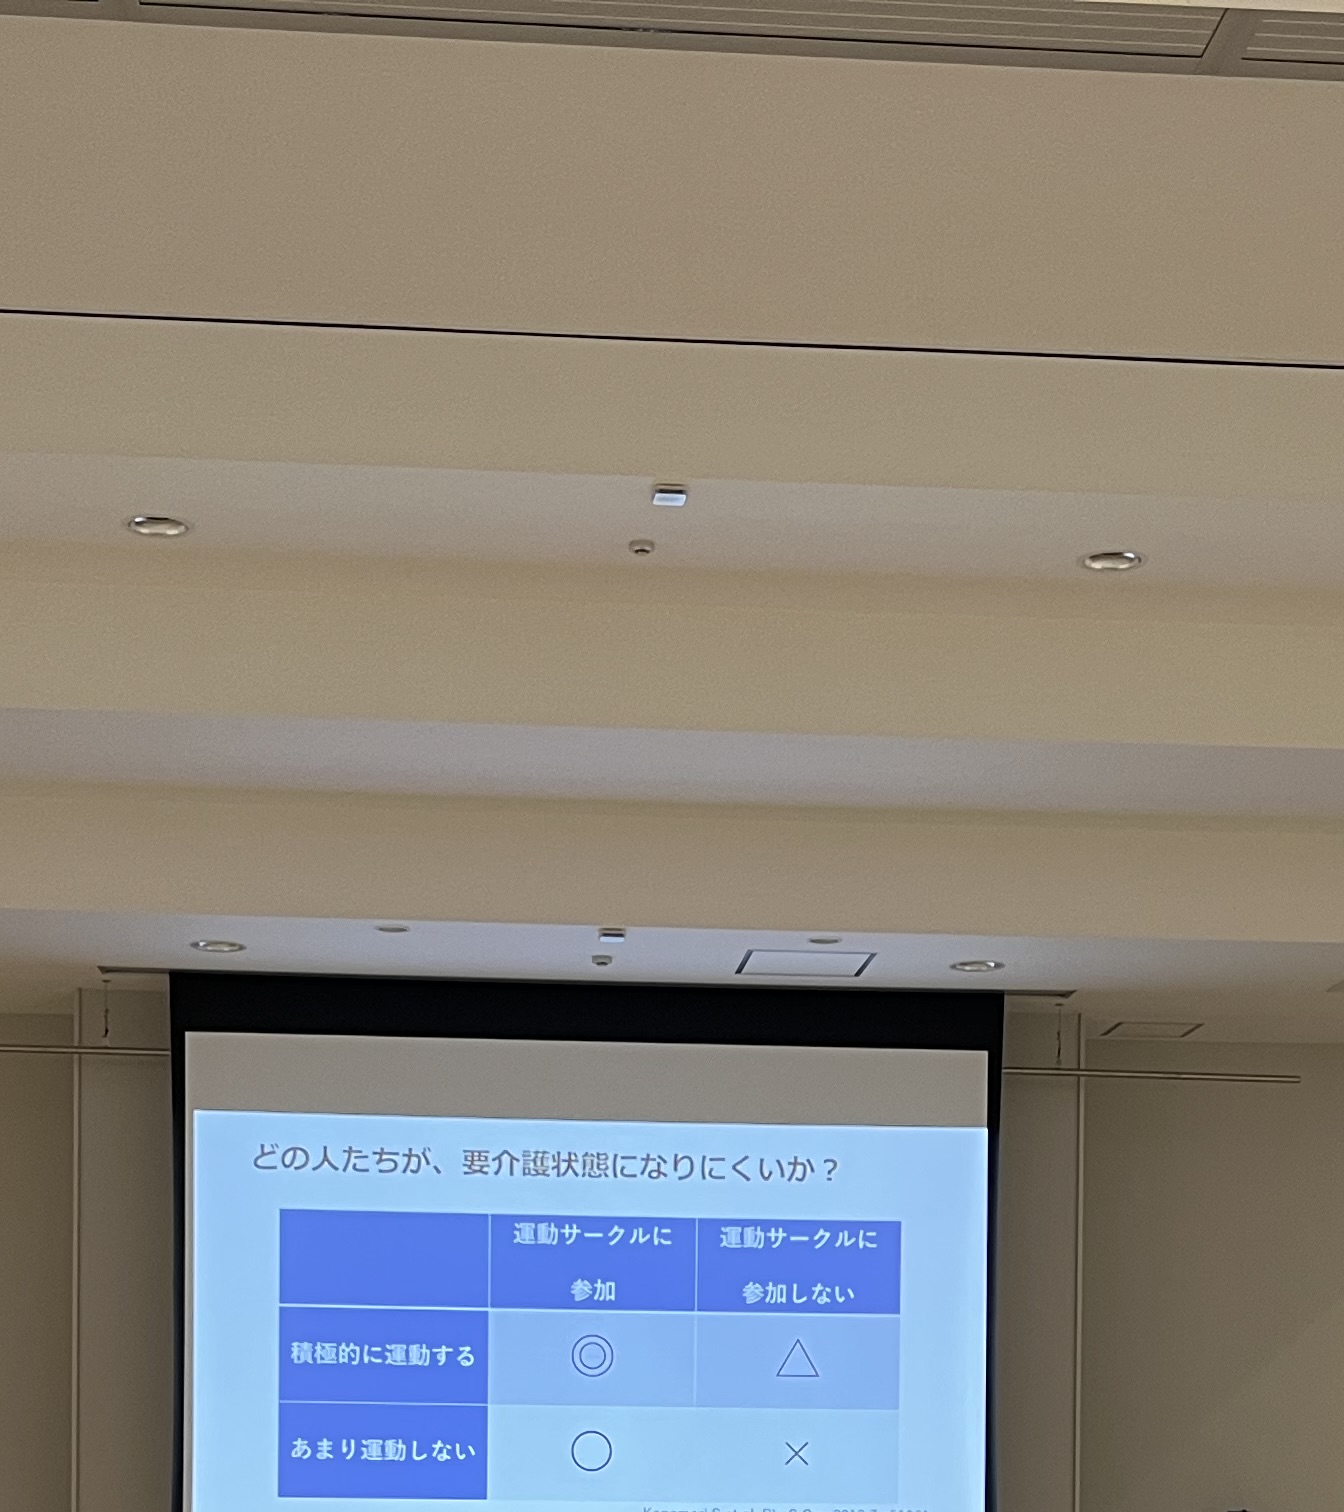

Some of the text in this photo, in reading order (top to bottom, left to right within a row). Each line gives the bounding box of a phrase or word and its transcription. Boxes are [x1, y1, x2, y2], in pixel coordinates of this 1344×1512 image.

[252, 1143, 840, 1182] どの人たちが、要介護状態になりにくいか？
[512, 1221, 673, 1247] 運動サークルに
[719, 1225, 879, 1250] 運動サークルに
[570, 1278, 616, 1302] 参加
[742, 1281, 856, 1305] 参加しない
[290, 1340, 476, 1368] 積極的に運動する
[290, 1436, 477, 1463] あまり運動しない
